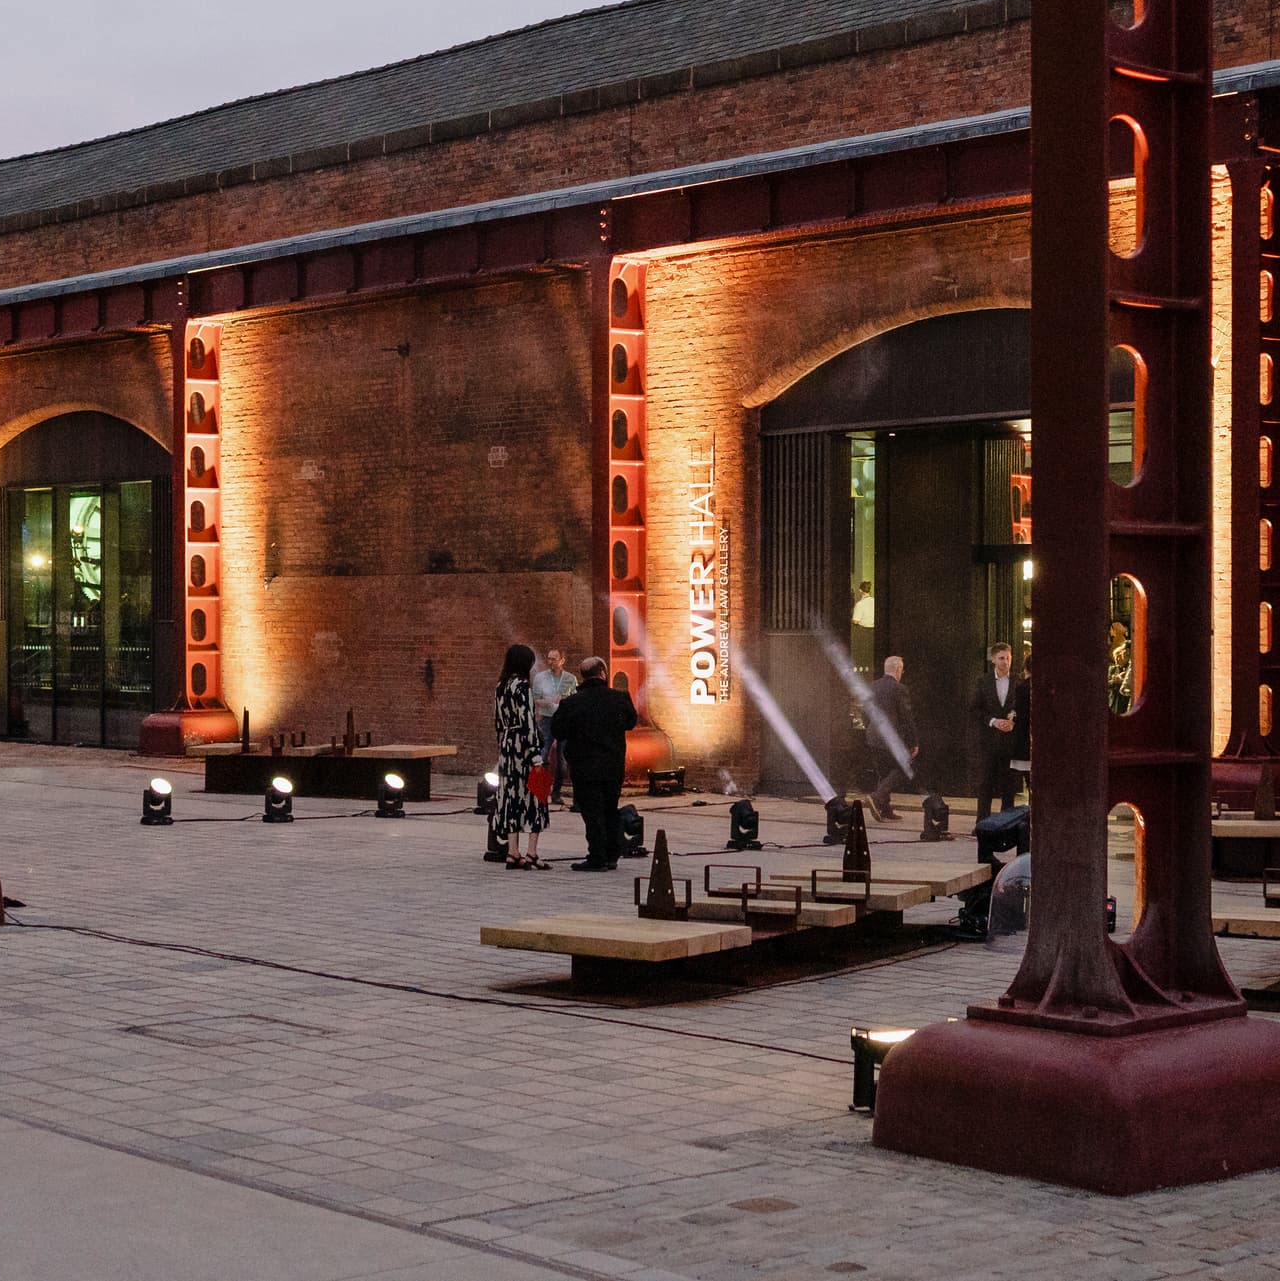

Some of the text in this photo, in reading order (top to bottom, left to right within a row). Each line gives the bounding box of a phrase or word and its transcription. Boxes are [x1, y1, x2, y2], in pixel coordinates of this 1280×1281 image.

[688, 445, 717, 705] POWER HALL
[719, 527, 729, 704] THE ANDREW LAW GALLERY
